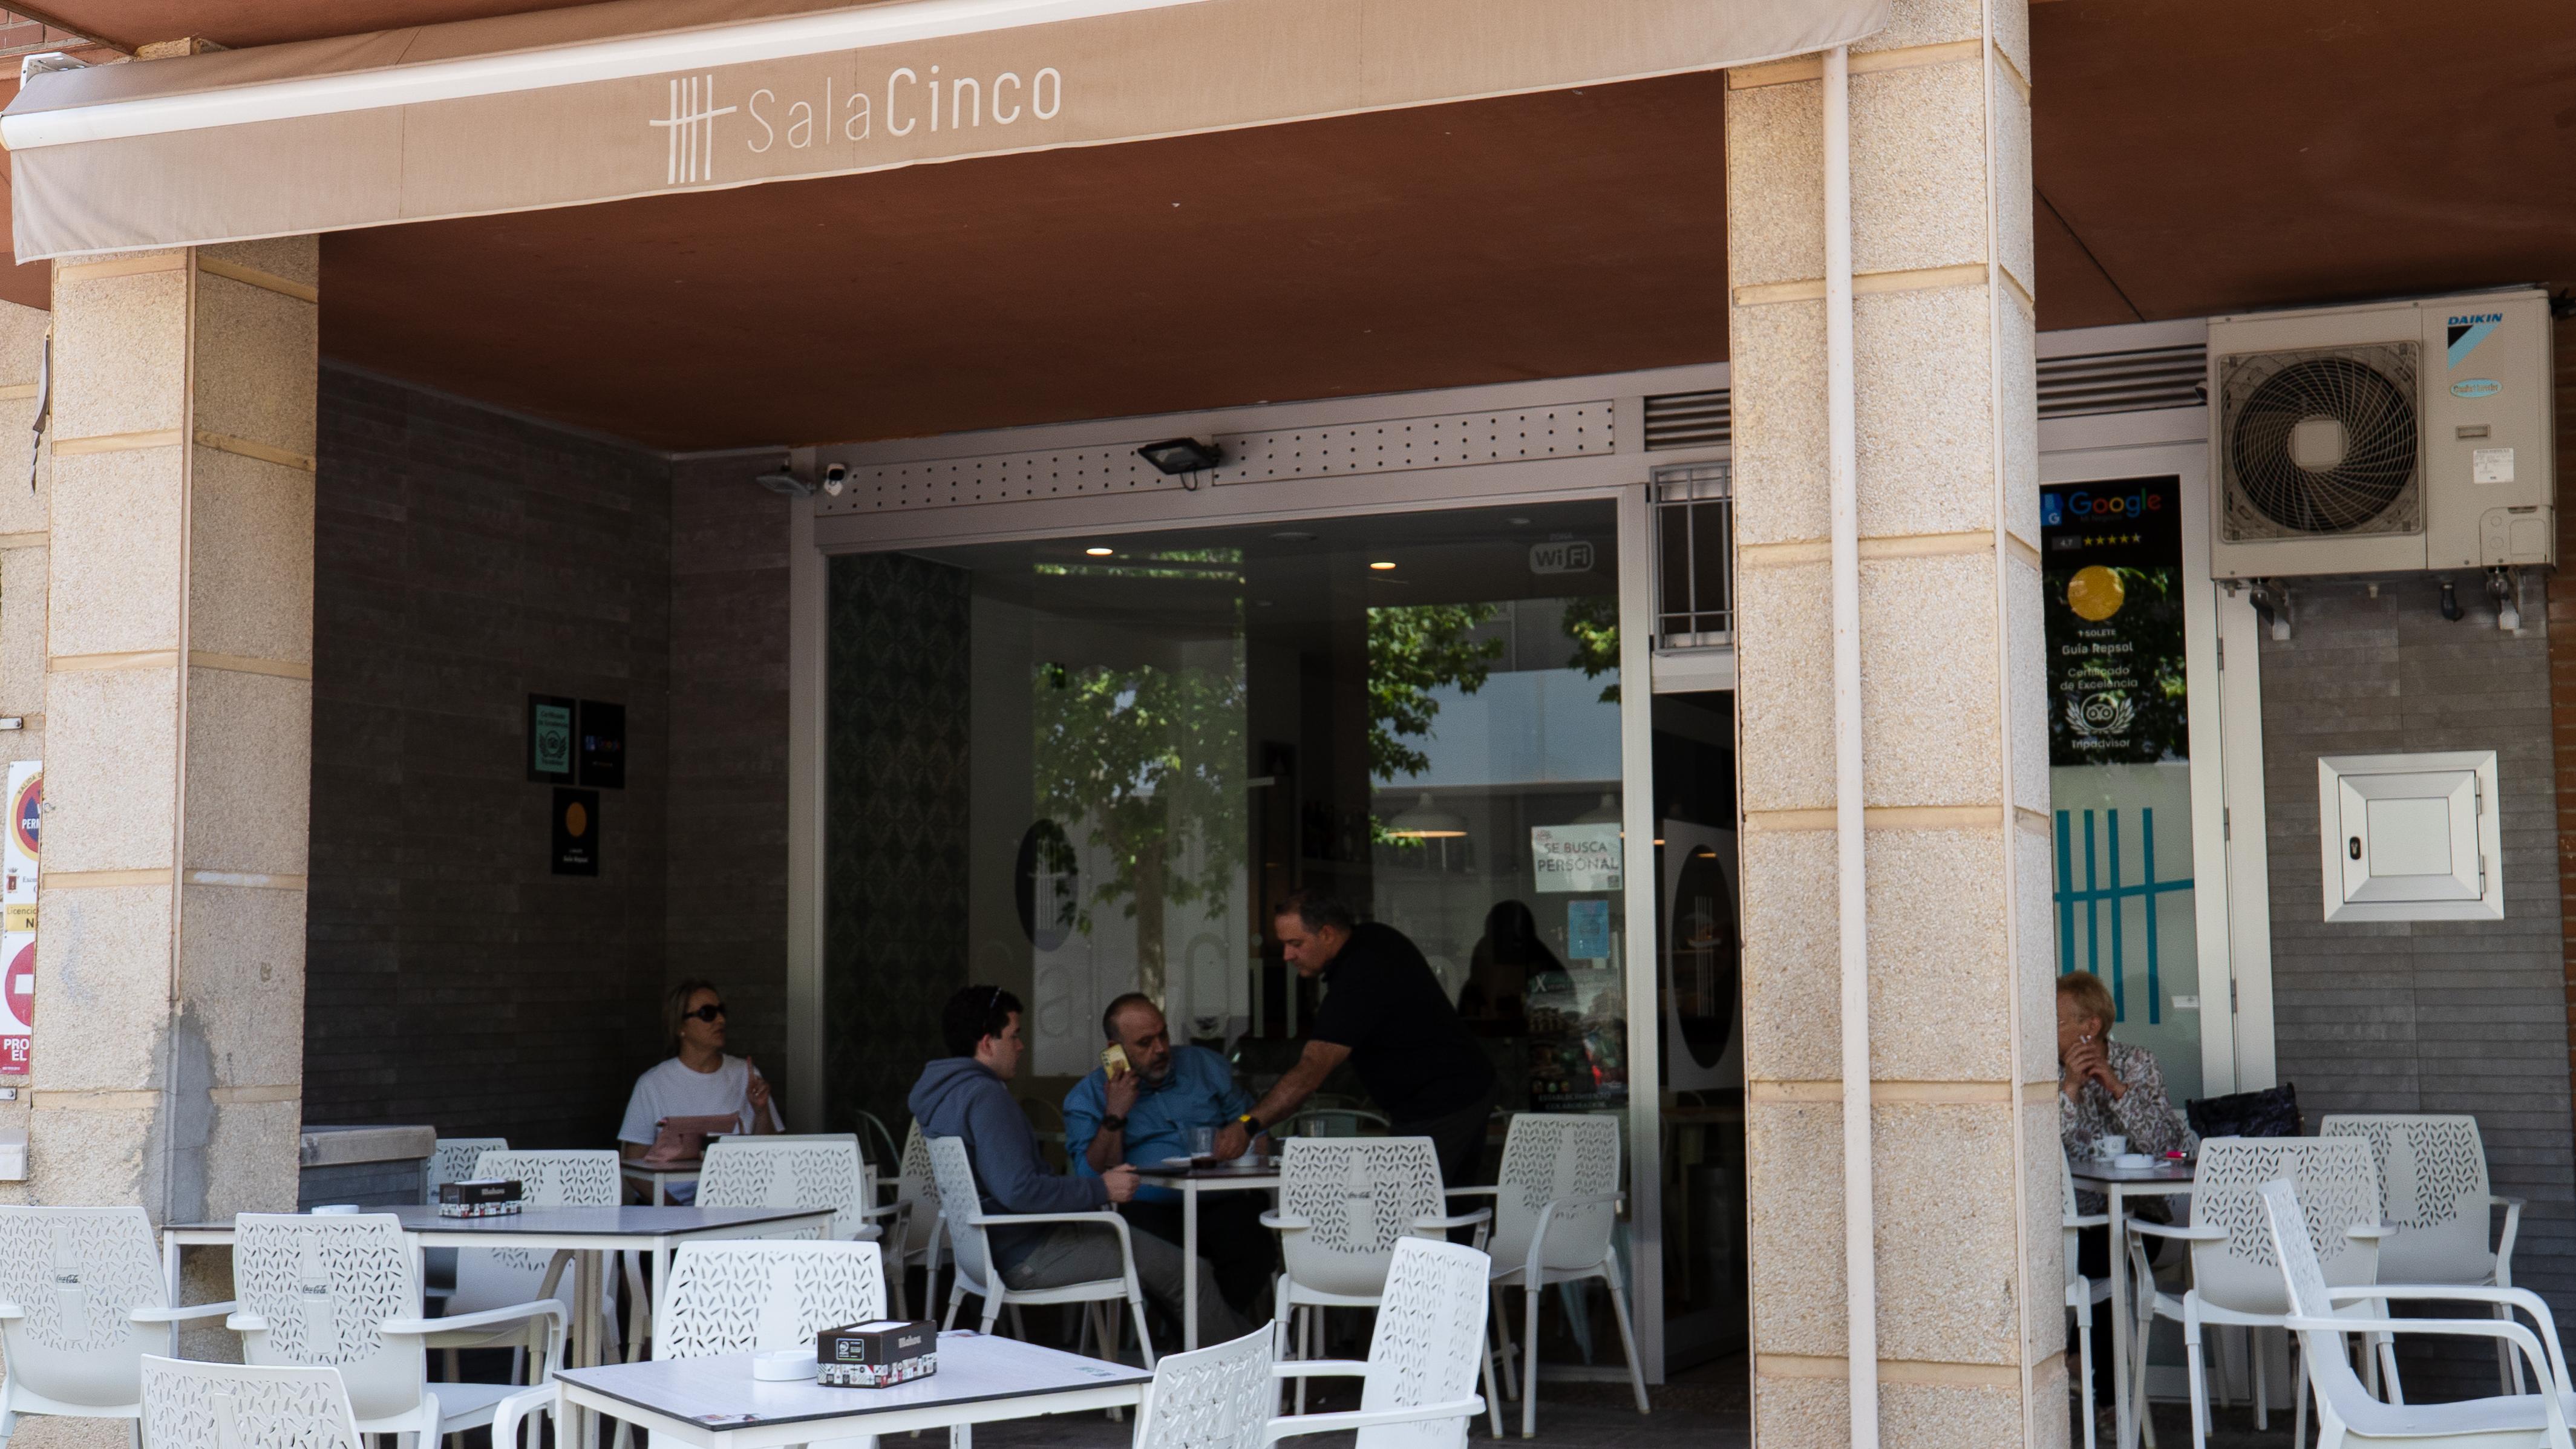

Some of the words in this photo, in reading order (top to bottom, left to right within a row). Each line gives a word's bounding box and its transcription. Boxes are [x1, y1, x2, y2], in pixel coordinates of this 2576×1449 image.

[2448, 313, 2503, 325] DAIKIN
[2068, 487, 2162, 518] Google
[2085, 629, 2116, 637] SOLETE
[2062, 643, 2088, 655] Guía
[2092, 641, 2133, 657] Repsol
[2068, 666, 2130, 677] Certificado
[2060, 680, 2074, 690] de
[2078, 678, 2139, 689] Excelencia
[2071, 739, 2130, 751] Tripadvisor
[1545, 842, 1559, 854] SE
[1564, 841, 1607, 853] BUSCA
[1537, 857, 1619, 872] PERSONAL
[11, 1050, 27, 1061] EL
